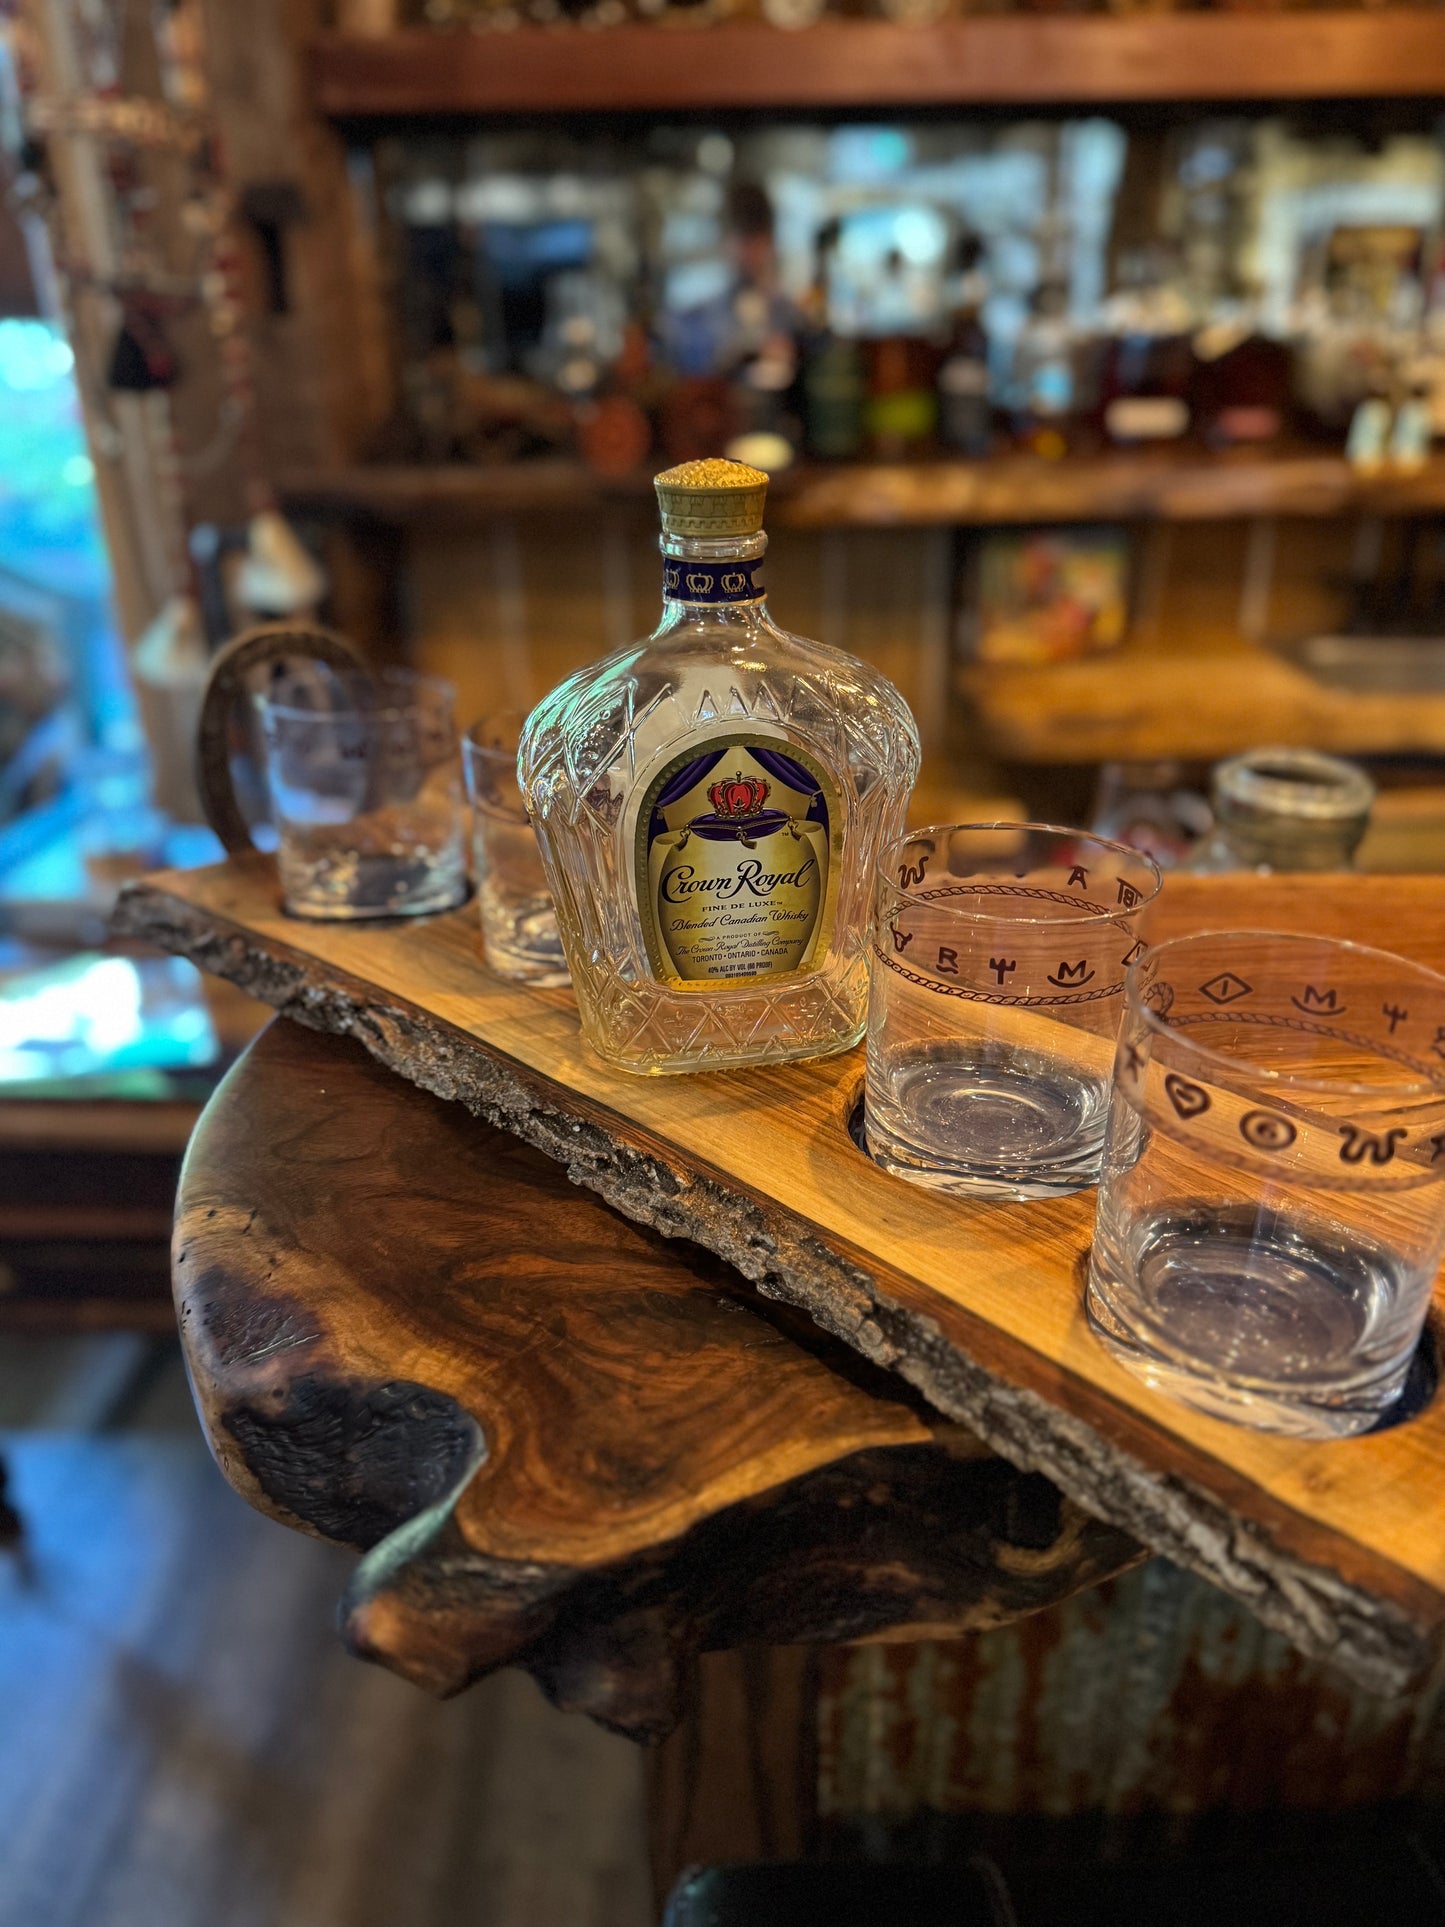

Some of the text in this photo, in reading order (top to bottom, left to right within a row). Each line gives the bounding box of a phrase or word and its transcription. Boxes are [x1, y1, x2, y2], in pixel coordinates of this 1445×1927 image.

[661, 859, 815, 903] Crown Royal
[671, 909, 809, 931] Blended Canadian Whisky
[676, 936, 804, 956] The Crown Royal Distilling Company
[692, 947, 788, 963] TORONTO ONTARIO CANADA
